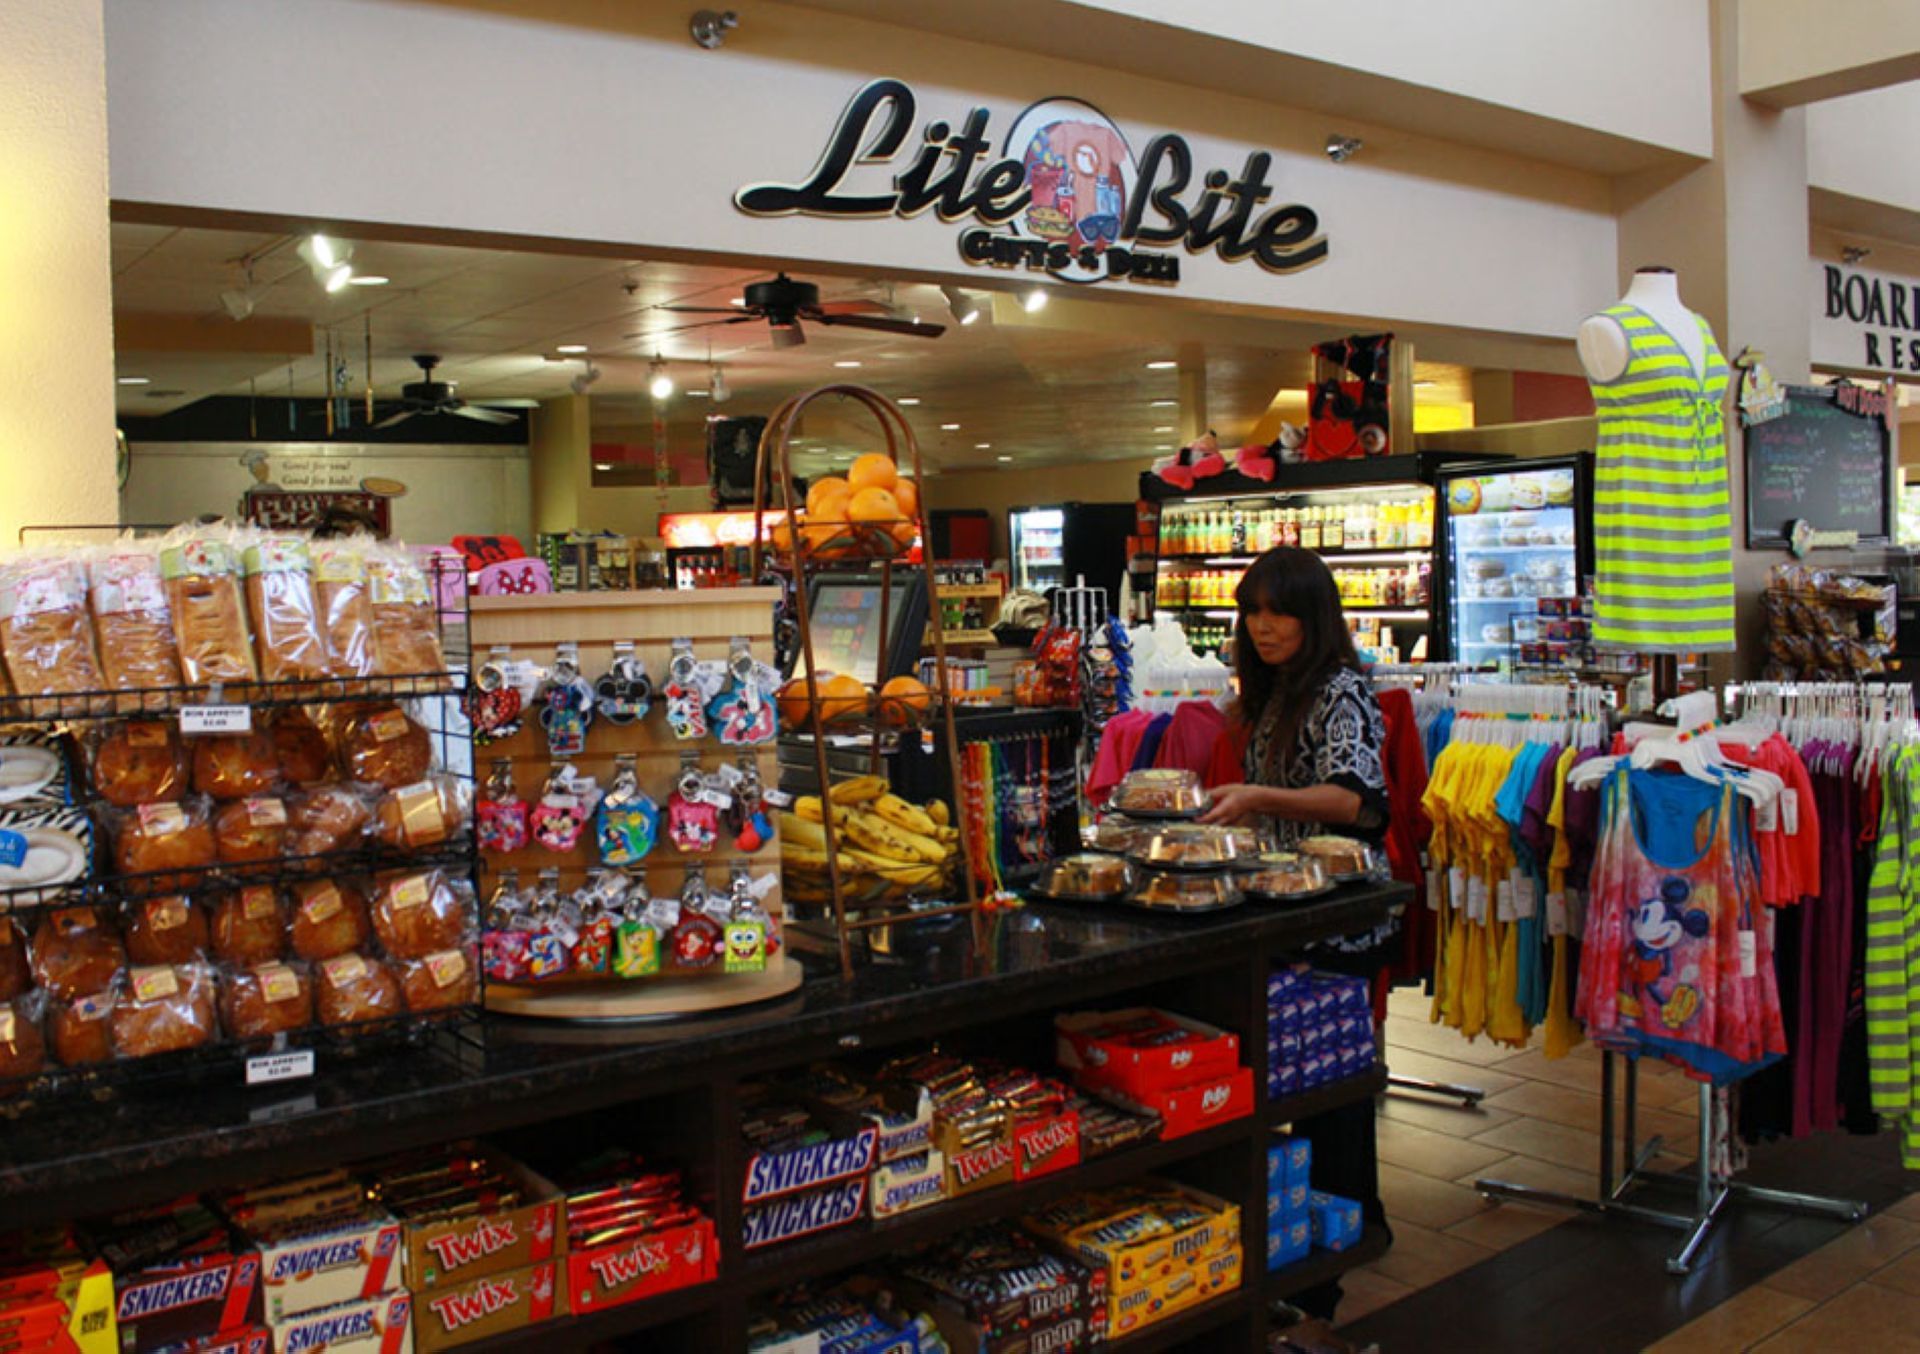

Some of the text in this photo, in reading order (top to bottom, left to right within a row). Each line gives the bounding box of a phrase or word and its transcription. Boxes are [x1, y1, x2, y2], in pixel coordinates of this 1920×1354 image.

[734, 78, 1329, 272] Lite Bite
[750, 1131, 873, 1197] SNICKERS
[1019, 1121, 1074, 1160] Twix
[273, 1239, 364, 1278] SNICKERS
[427, 1219, 518, 1270] Twix
[591, 1240, 670, 1290] Twix
[119, 1267, 229, 1320] SNICKERS
[430, 1279, 520, 1331] Twix
[287, 1309, 374, 1354] SNICKERS
